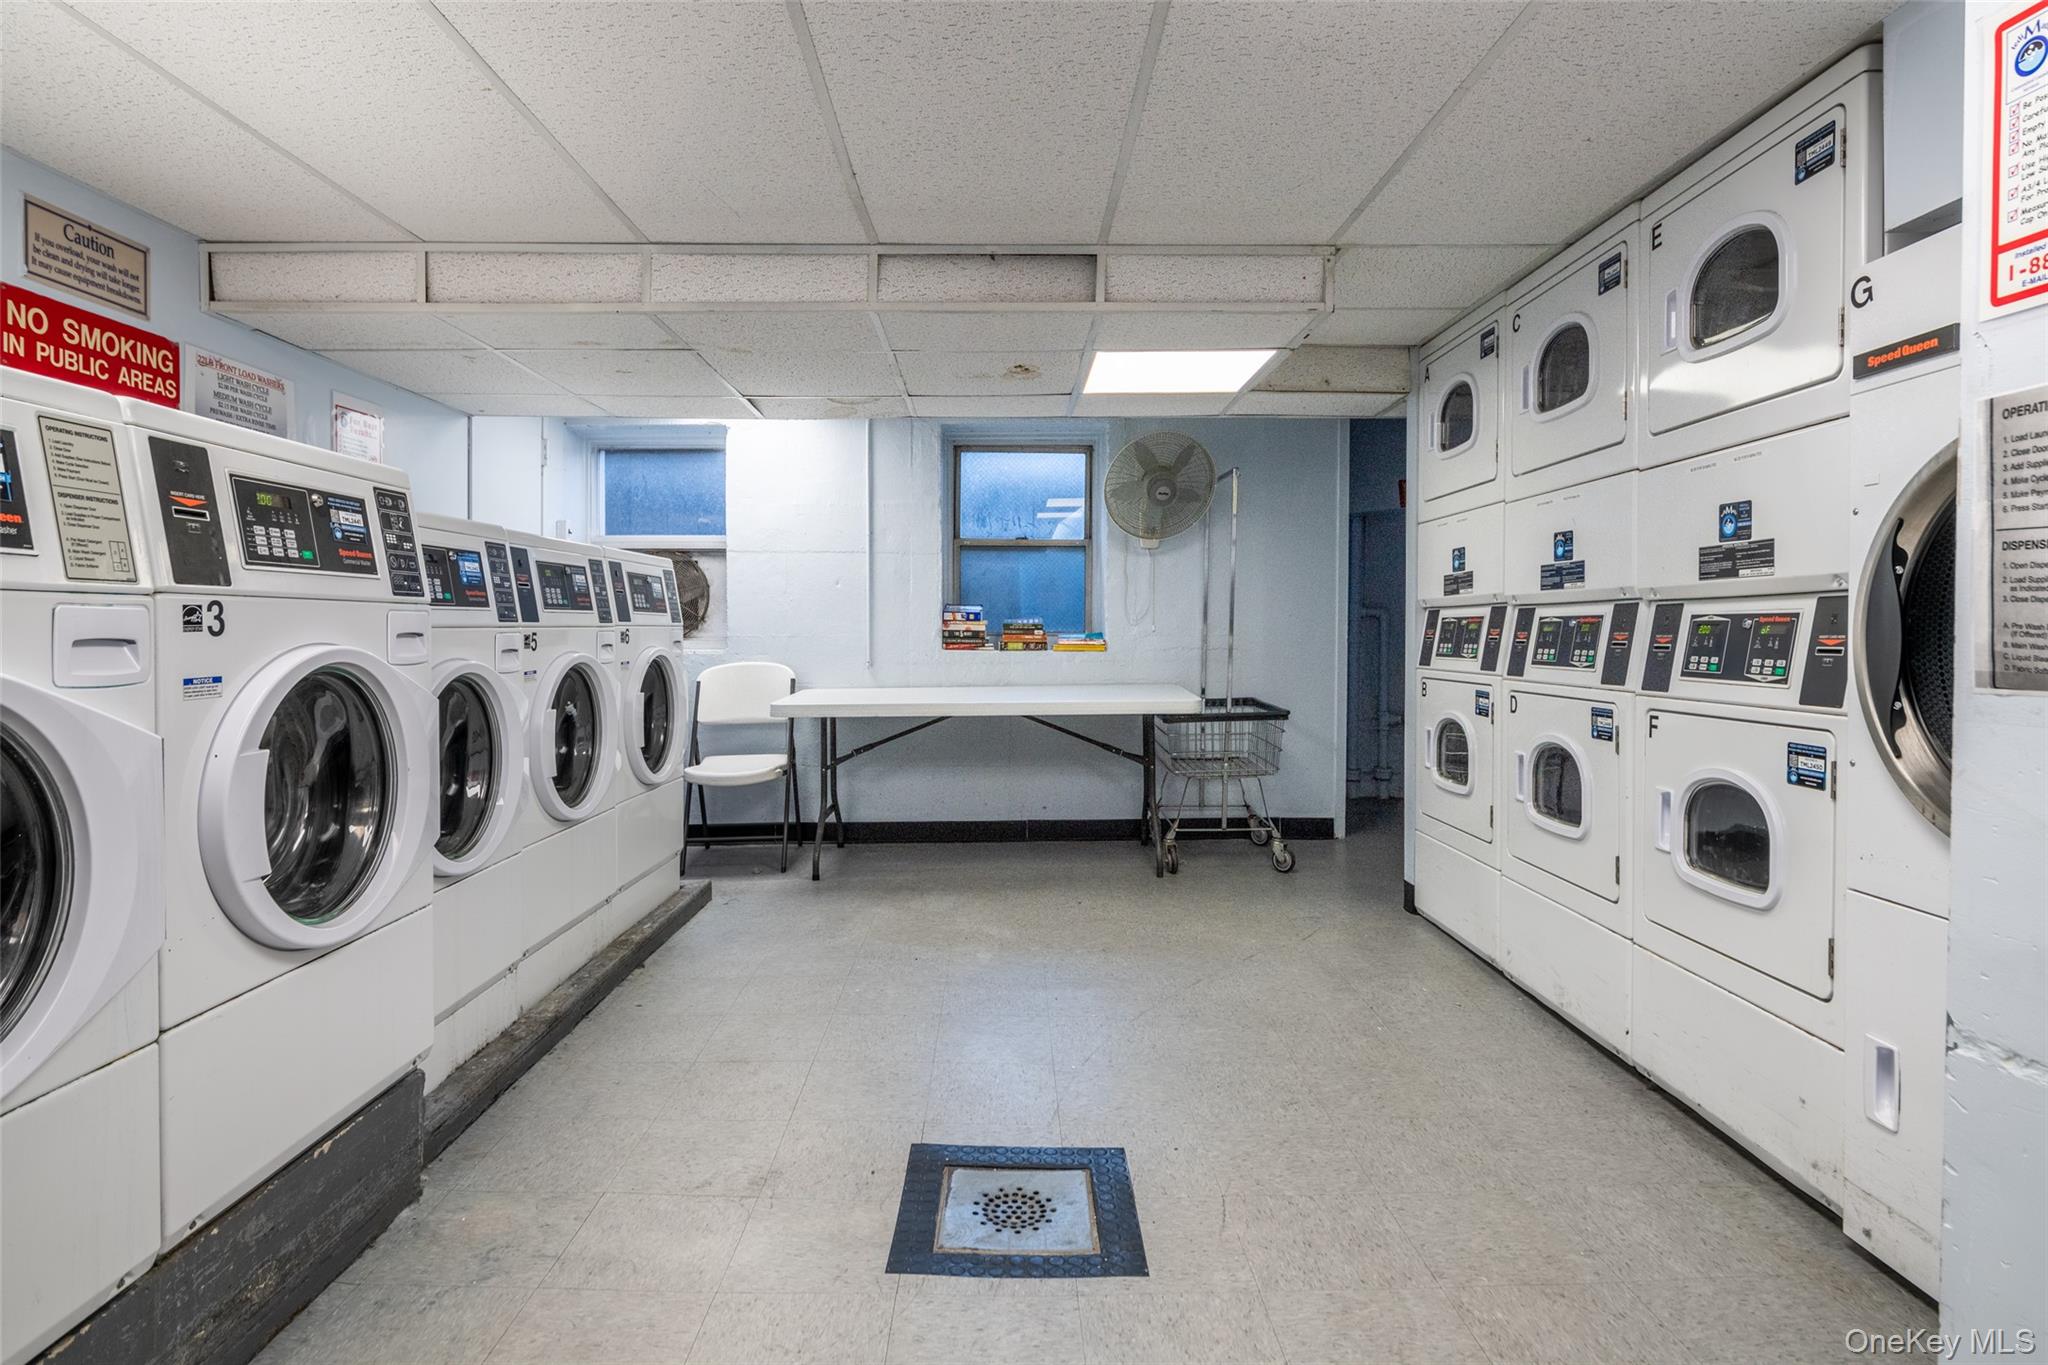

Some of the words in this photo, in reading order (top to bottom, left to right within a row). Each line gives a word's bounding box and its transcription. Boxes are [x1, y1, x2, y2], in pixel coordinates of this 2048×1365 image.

[64, 224, 114, 258] Caution
[1652, 222, 1662, 251] E
[33, 244, 42, 254] be
[42, 250, 60, 262] clean
[61, 256, 74, 268] and
[74, 261, 96, 278] drying
[96, 270, 108, 280] will
[108, 275, 121, 286] take
[41, 238, 54, 249] you
[86, 254, 100, 266] your
[102, 260, 117, 272] wash
[118, 266, 129, 278] will
[130, 274, 139, 282] not
[38, 260, 53, 274] may
[54, 266, 72, 278] cause
[73, 272, 106, 288] equipment
[1850, 276, 1874, 309] G
[1512, 314, 1520, 333] C
[6, 299, 48, 335] NO
[62, 318, 174, 374] SMOKING
[1868, 347, 1902, 368] Speed
[1902, 338, 1939, 356] Queen
[3, 331, 25, 358] IN
[36, 341, 110, 380] PUBLIC
[118, 366, 176, 399] AREAS
[238, 368, 256, 381] LOAD
[1424, 366, 1430, 384] A
[236, 378, 252, 389] WASH
[238, 398, 254, 409] WASH
[2002, 539, 2048, 550] DISPENS
[207, 600, 225, 637] 3
[531, 632, 538, 652] 5
[626, 628, 630, 644] 6
[1422, 682, 1427, 697] B
[1510, 695, 1518, 713] D
[1649, 715, 1659, 738] F
